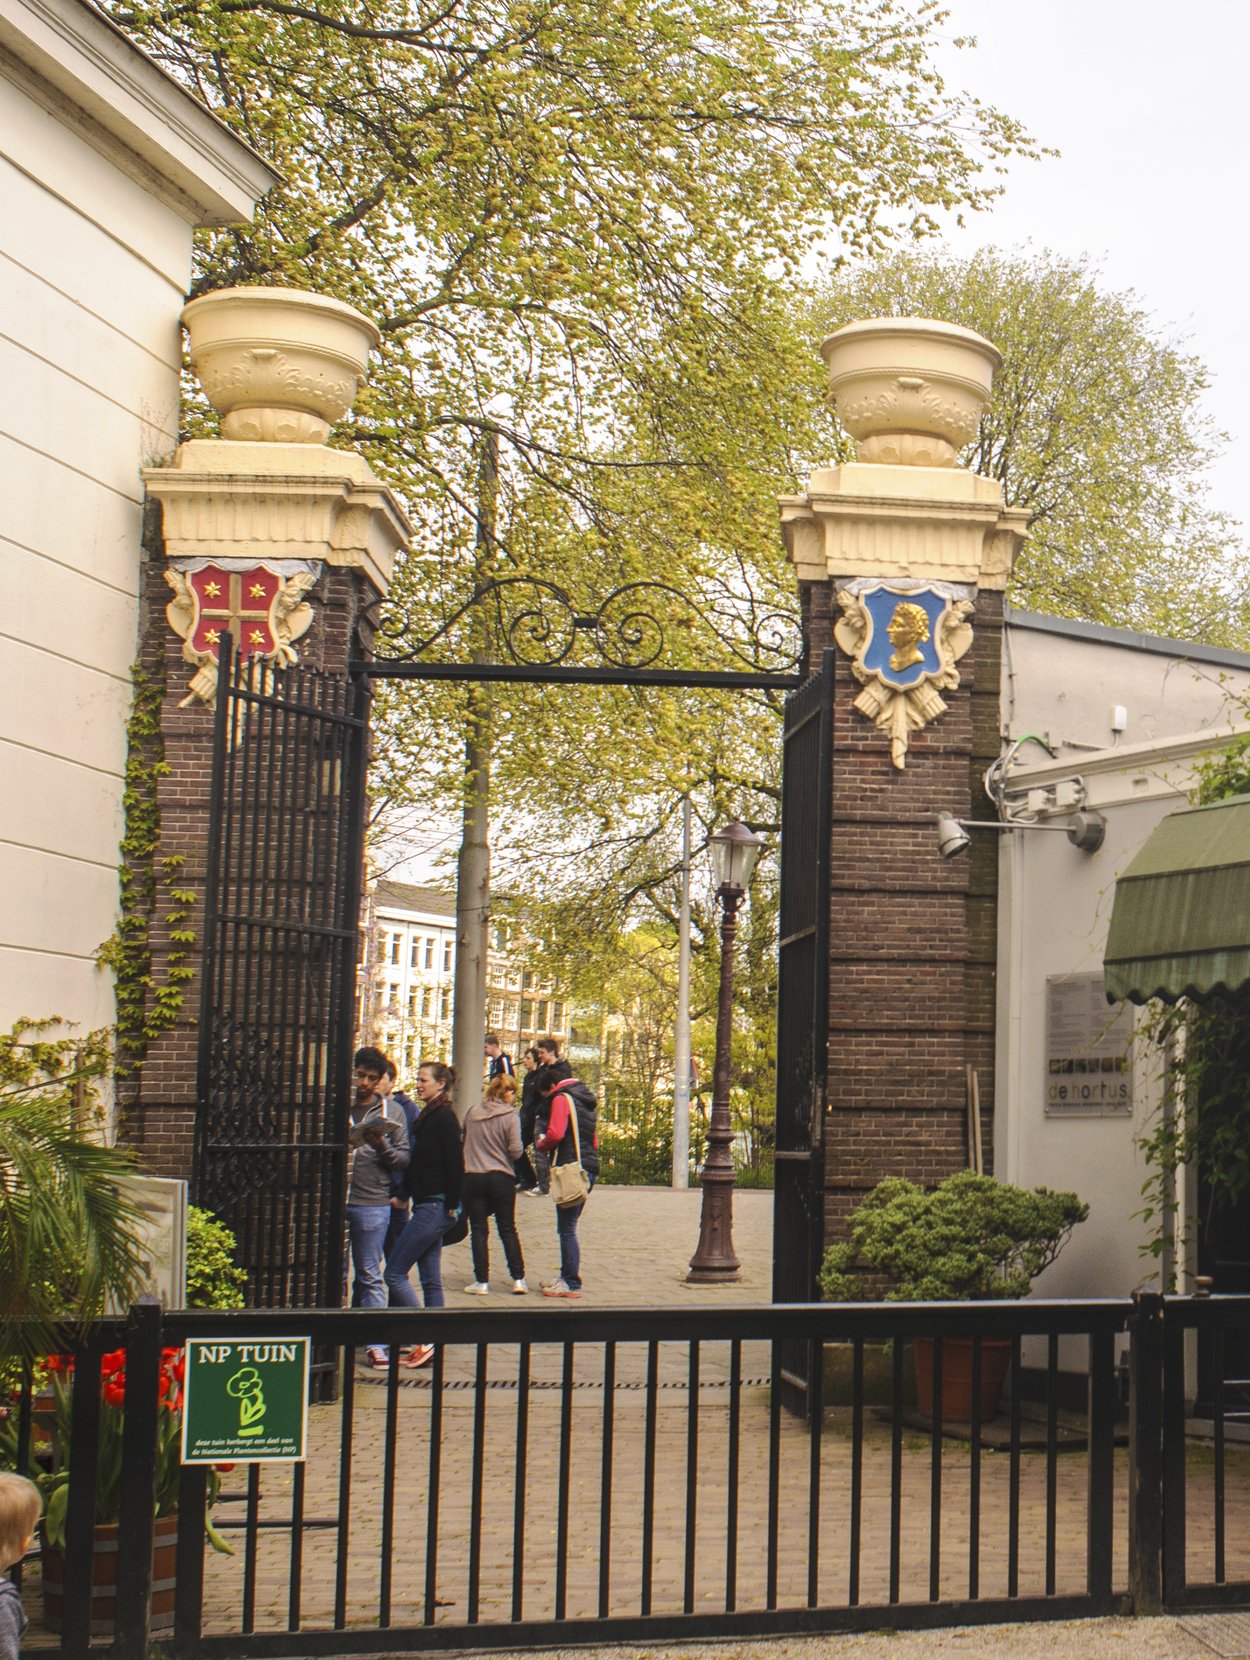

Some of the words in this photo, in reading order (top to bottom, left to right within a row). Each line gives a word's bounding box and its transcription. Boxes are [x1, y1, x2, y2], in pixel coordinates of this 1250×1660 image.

[1048, 1081, 1067, 1099] de
[1071, 1081, 1127, 1099] hortus
[198, 1345, 231, 1363] NP
[237, 1344, 297, 1363] TUIN
[211, 1438, 225, 1446] tuin
[191, 1448, 200, 1456] de
[201, 1447, 232, 1455] Nationale
